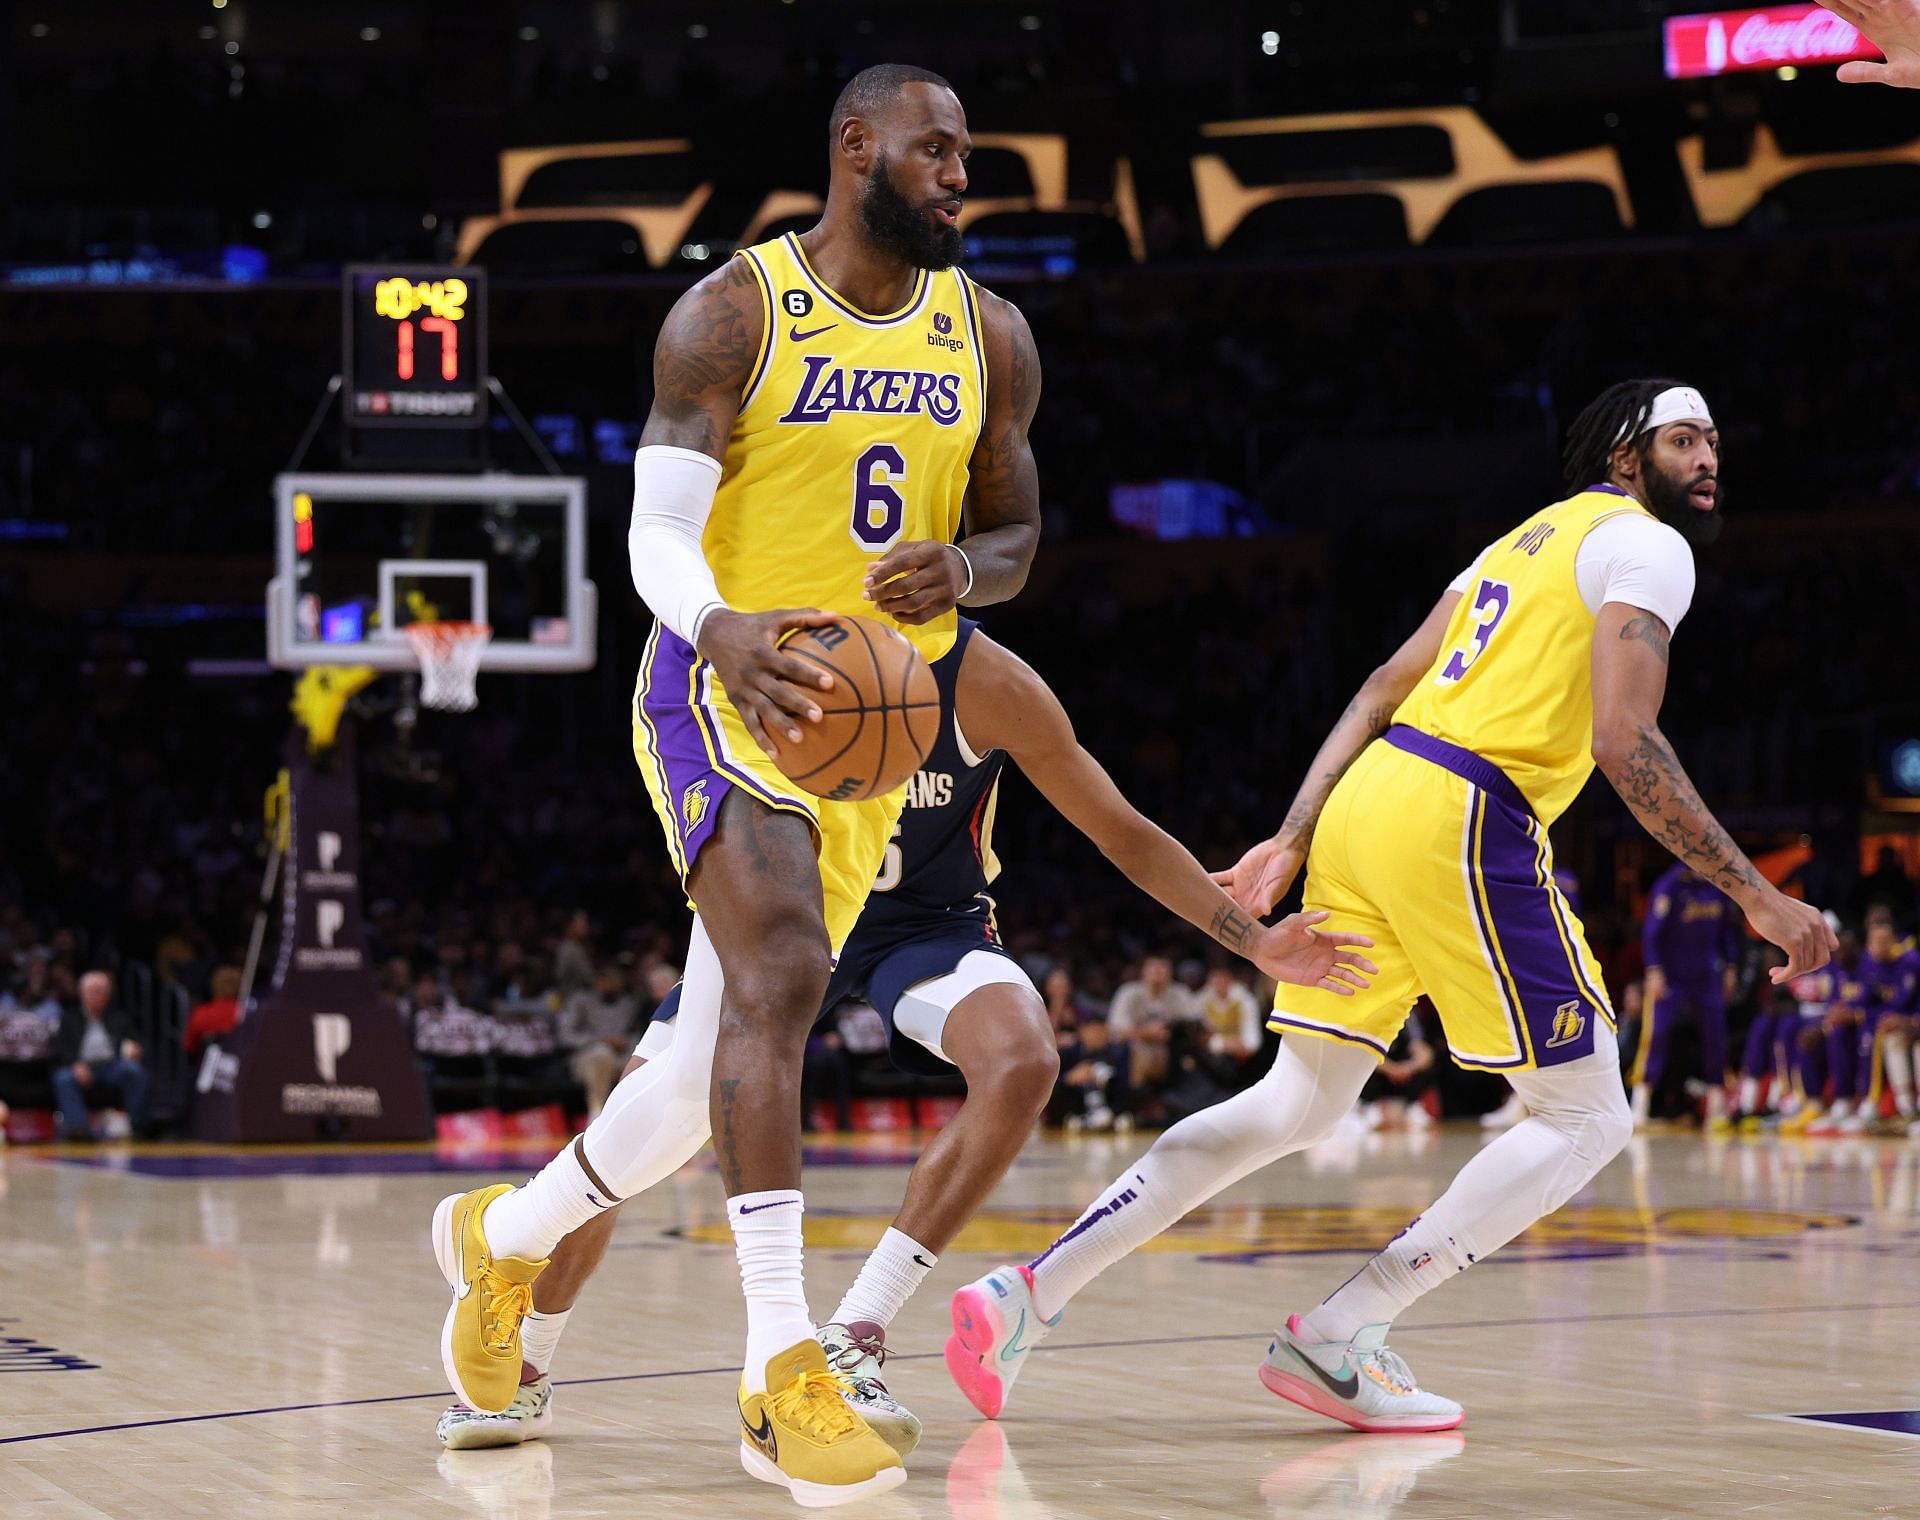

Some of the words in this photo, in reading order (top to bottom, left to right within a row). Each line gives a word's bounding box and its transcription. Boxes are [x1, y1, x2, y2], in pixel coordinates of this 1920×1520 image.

[376, 277, 468, 320] 10:42
[788, 293, 806, 314] 6
[398, 316, 458, 381] 17
[927, 333, 964, 353] bibigo
[777, 354, 963, 427] LAKERS
[849, 442, 906, 553] 6
[1435, 576, 1511, 686] 3
